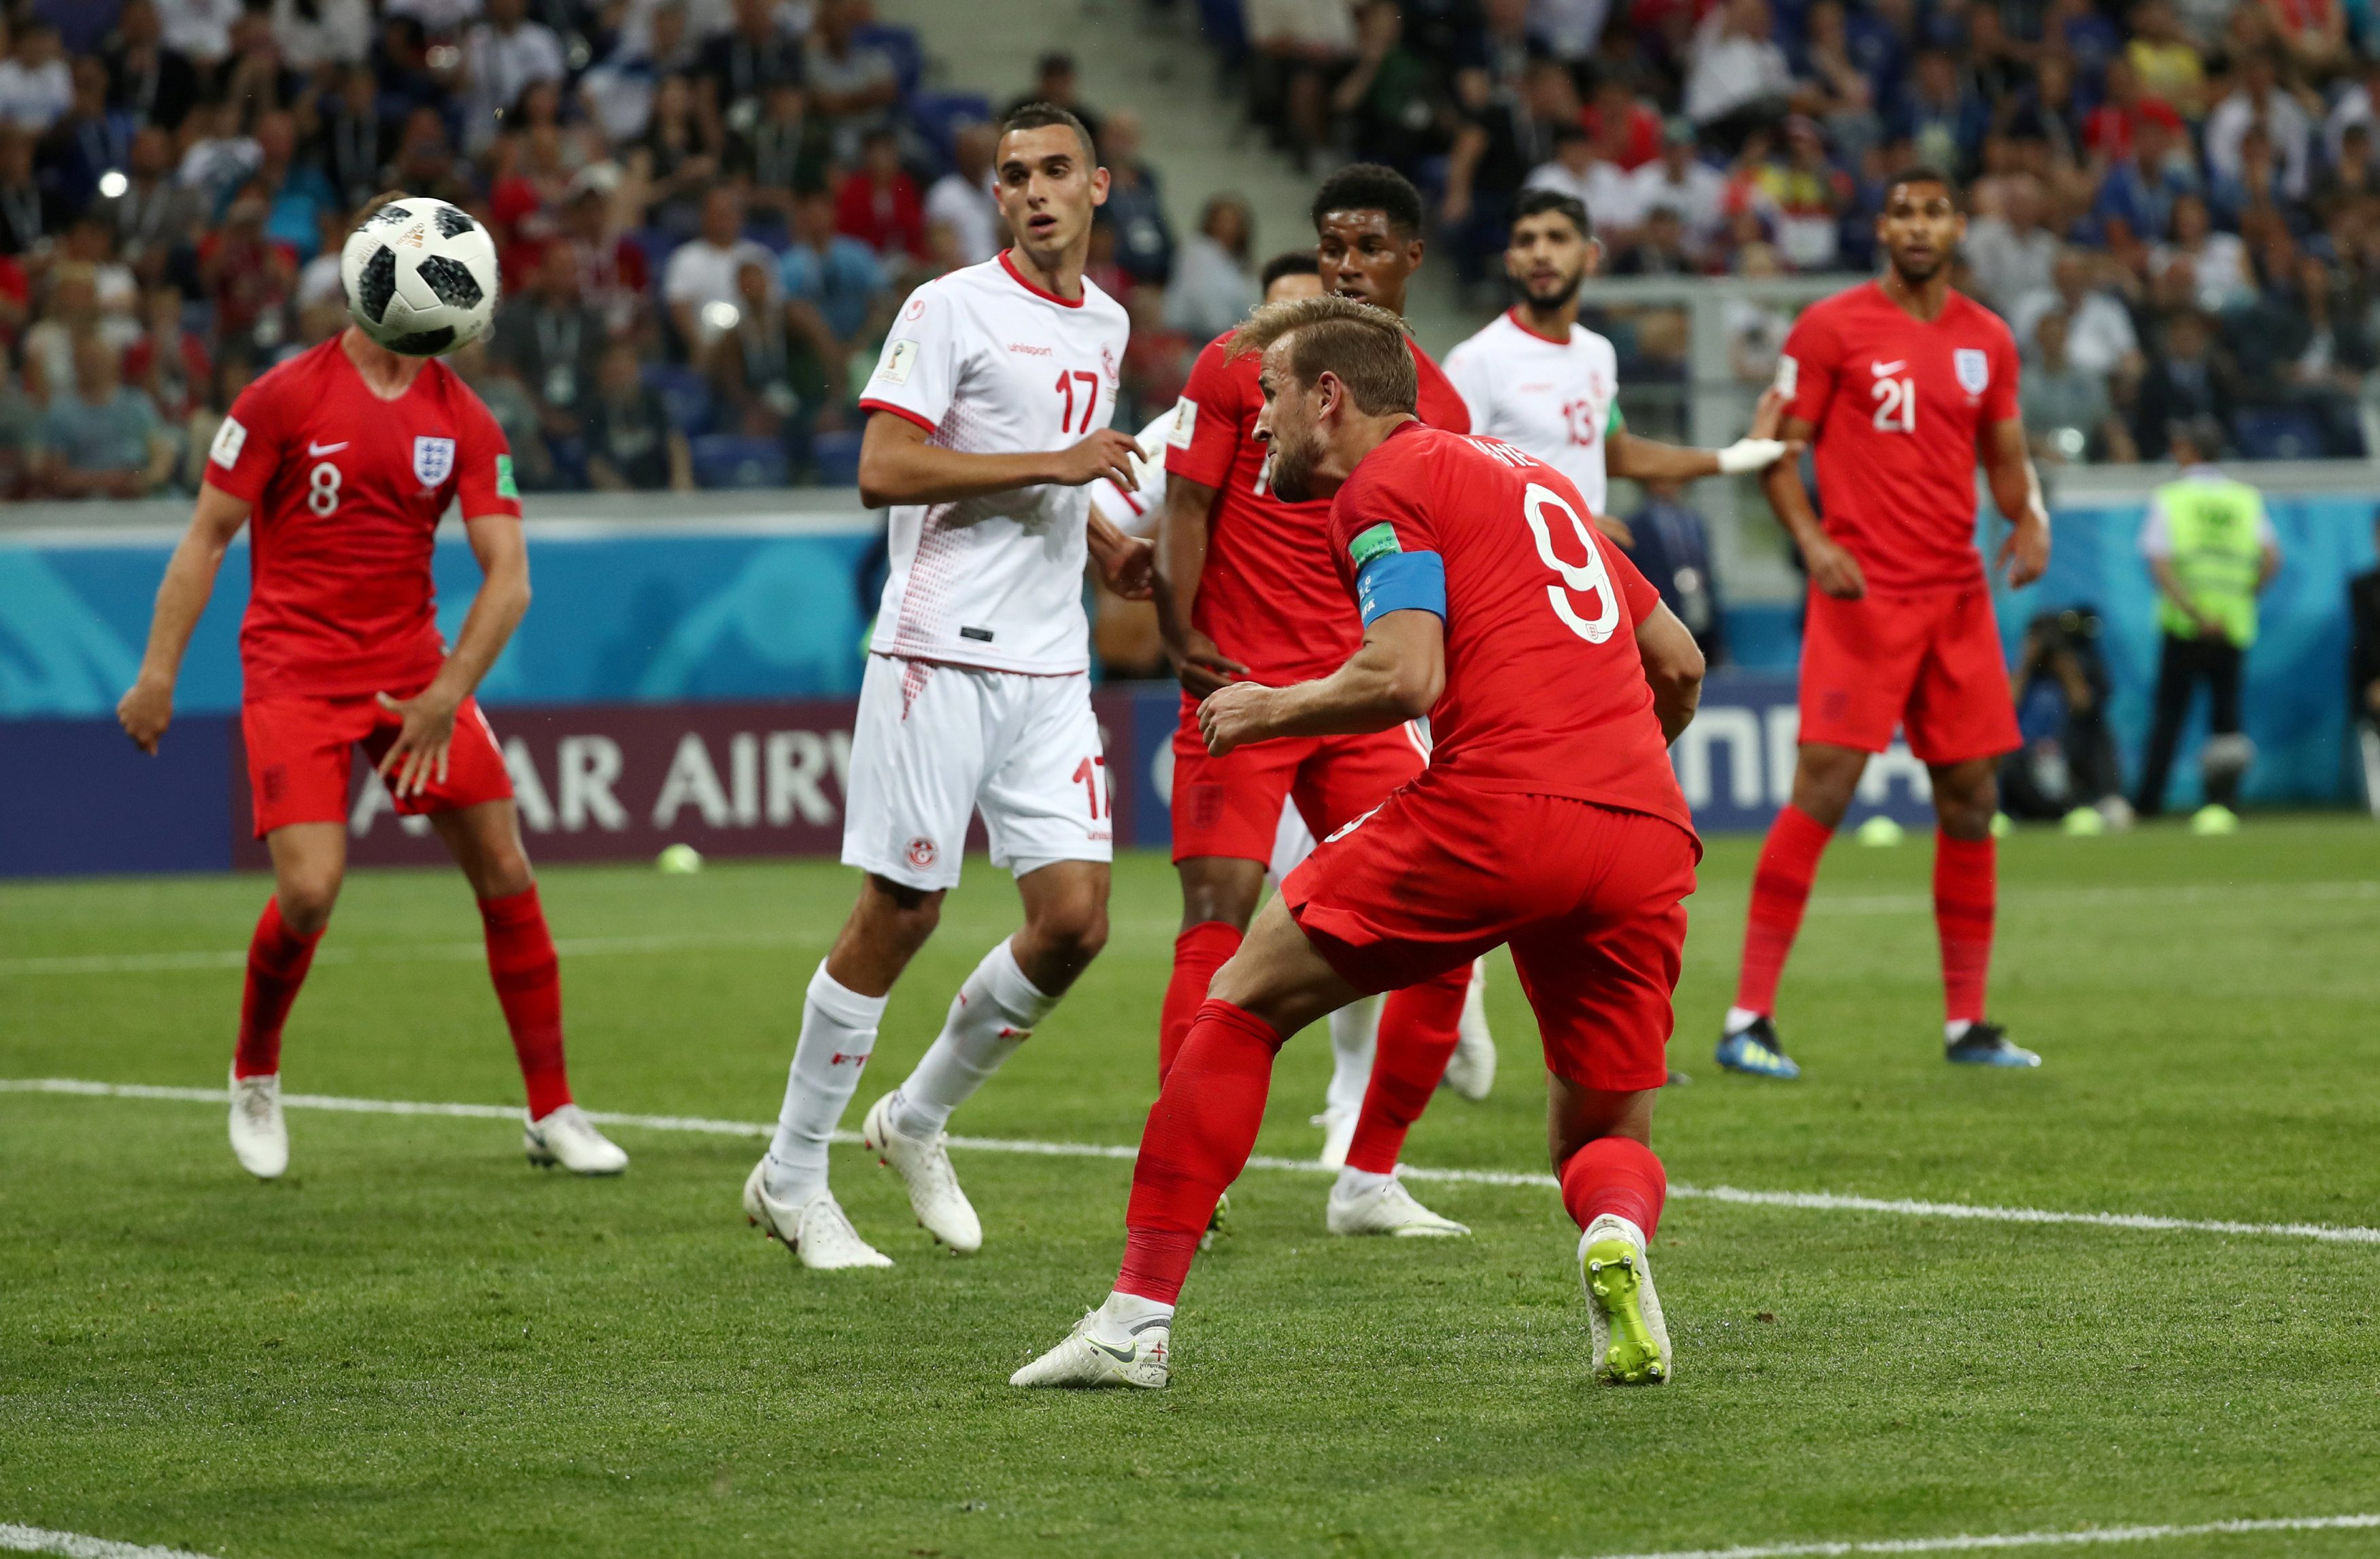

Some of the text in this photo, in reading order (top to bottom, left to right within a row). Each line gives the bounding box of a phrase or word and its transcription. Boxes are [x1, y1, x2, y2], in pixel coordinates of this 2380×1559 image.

[1055, 369, 1098, 434] 17
[1562, 398, 1595, 447] 13
[1871, 377, 1916, 433] 21
[307, 462, 342, 517] 8
[1523, 482, 1620, 645] 9
